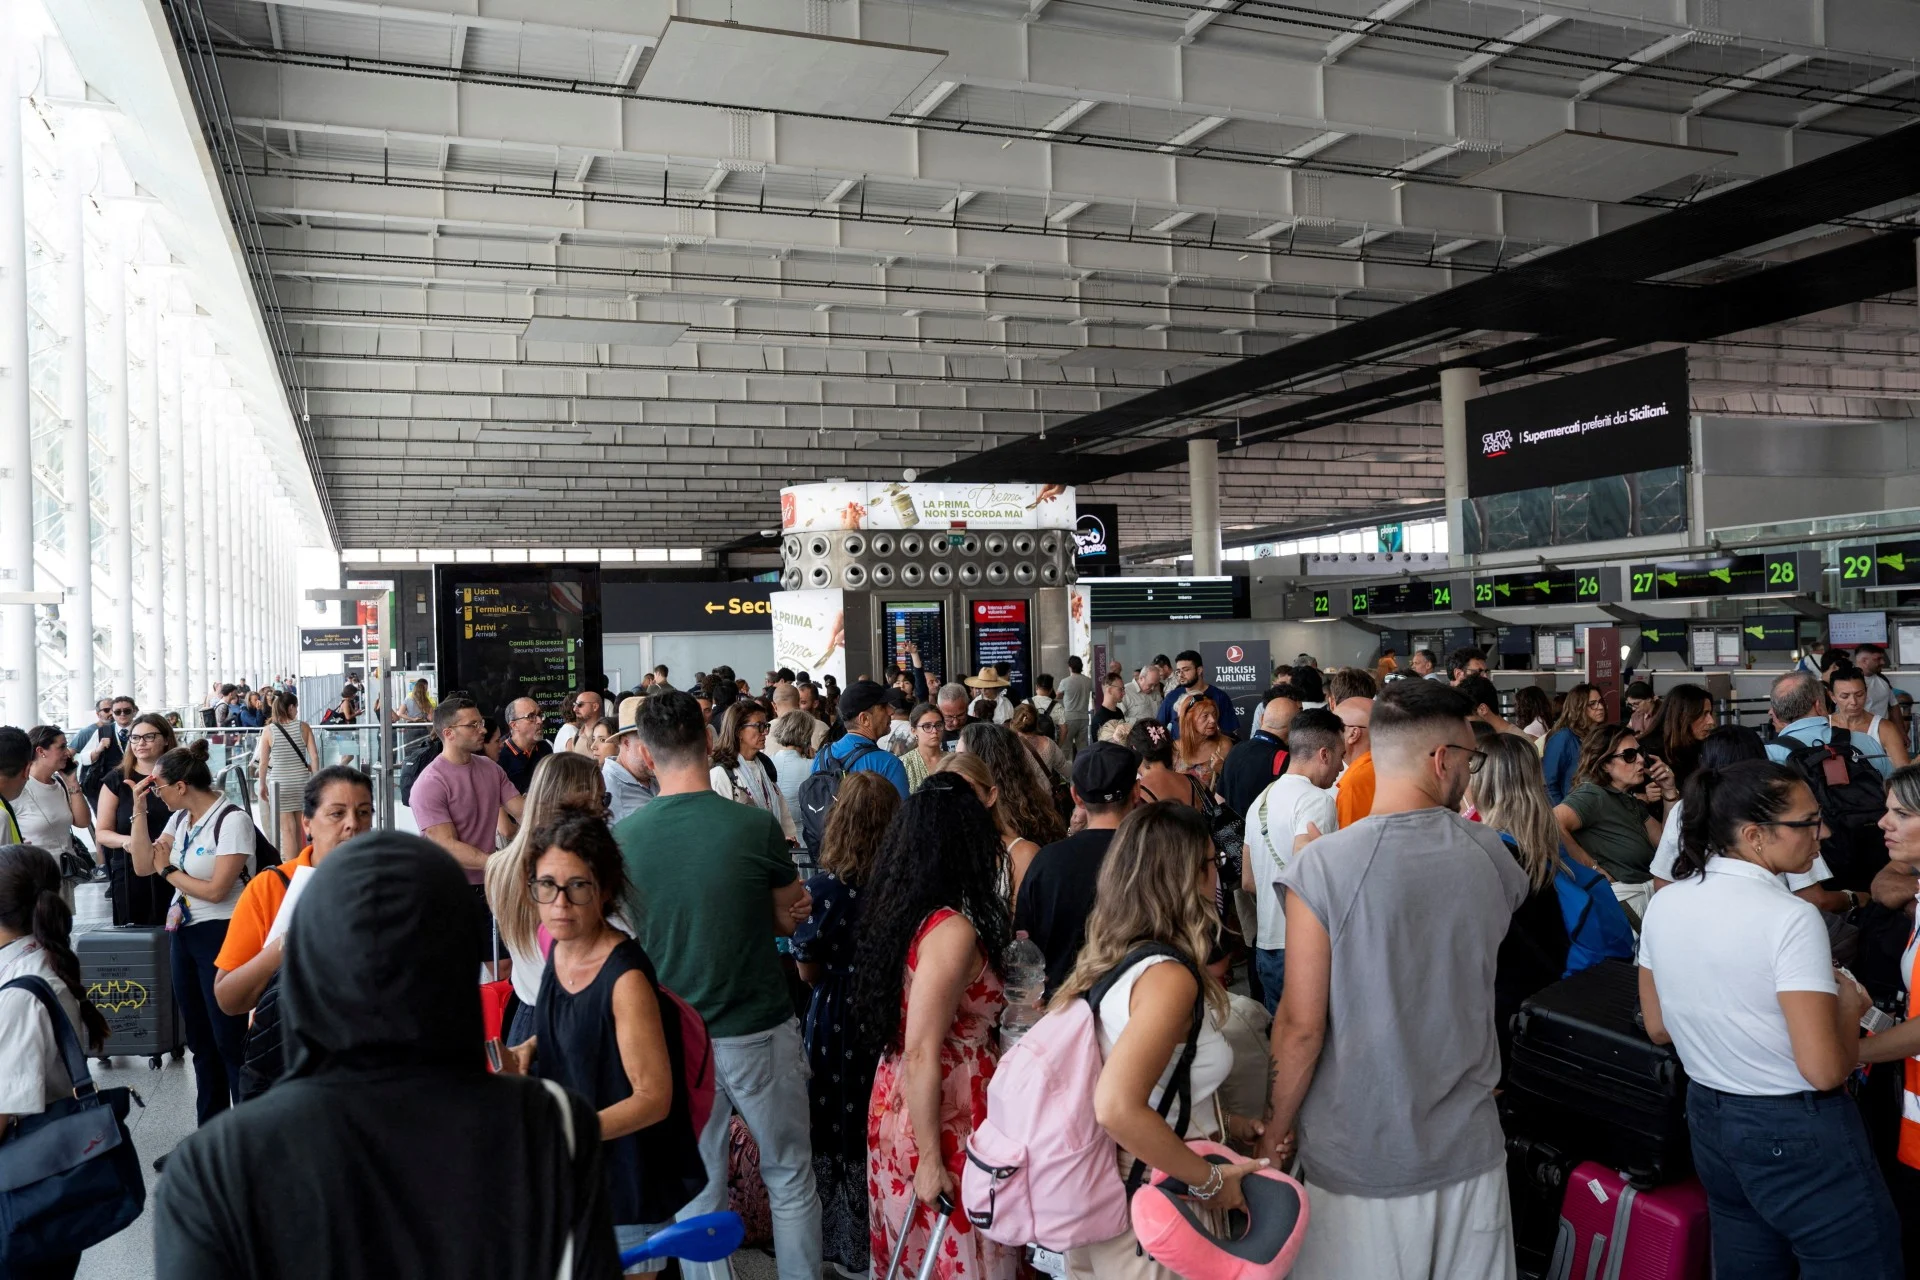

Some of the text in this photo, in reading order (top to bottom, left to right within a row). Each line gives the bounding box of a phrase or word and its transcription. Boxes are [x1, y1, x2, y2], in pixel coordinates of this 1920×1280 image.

[1523, 420, 1580, 444] Supermercati
[1581, 415, 1611, 435] preferiti
[1613, 411, 1627, 425] dai
[1629, 402, 1669, 422] Siciliani.
[1482, 429, 1511, 444] GRUPPO
[925, 510, 1023, 518] NON SI SCORDA MAI
[1769, 562, 1794, 584] 28
[1844, 555, 1871, 578] 29
[1579, 577, 1598, 595] 26
[1633, 573, 1653, 593] 27
[474, 587, 499, 596] Uscita
[1434, 588, 1450, 605] 24
[1476, 584, 1492, 601] 25
[475, 605, 508, 613] Terminal
[728, 598, 771, 614] Secu
[1315, 597, 1328, 611] 22
[1354, 594, 1367, 610] 23
[475, 623, 496, 631] Arrivi
[780, 611, 812, 629] PRIMA
[1216, 666, 1255, 674] TURKISH
[1216, 674, 1256, 682] AIRLINES
